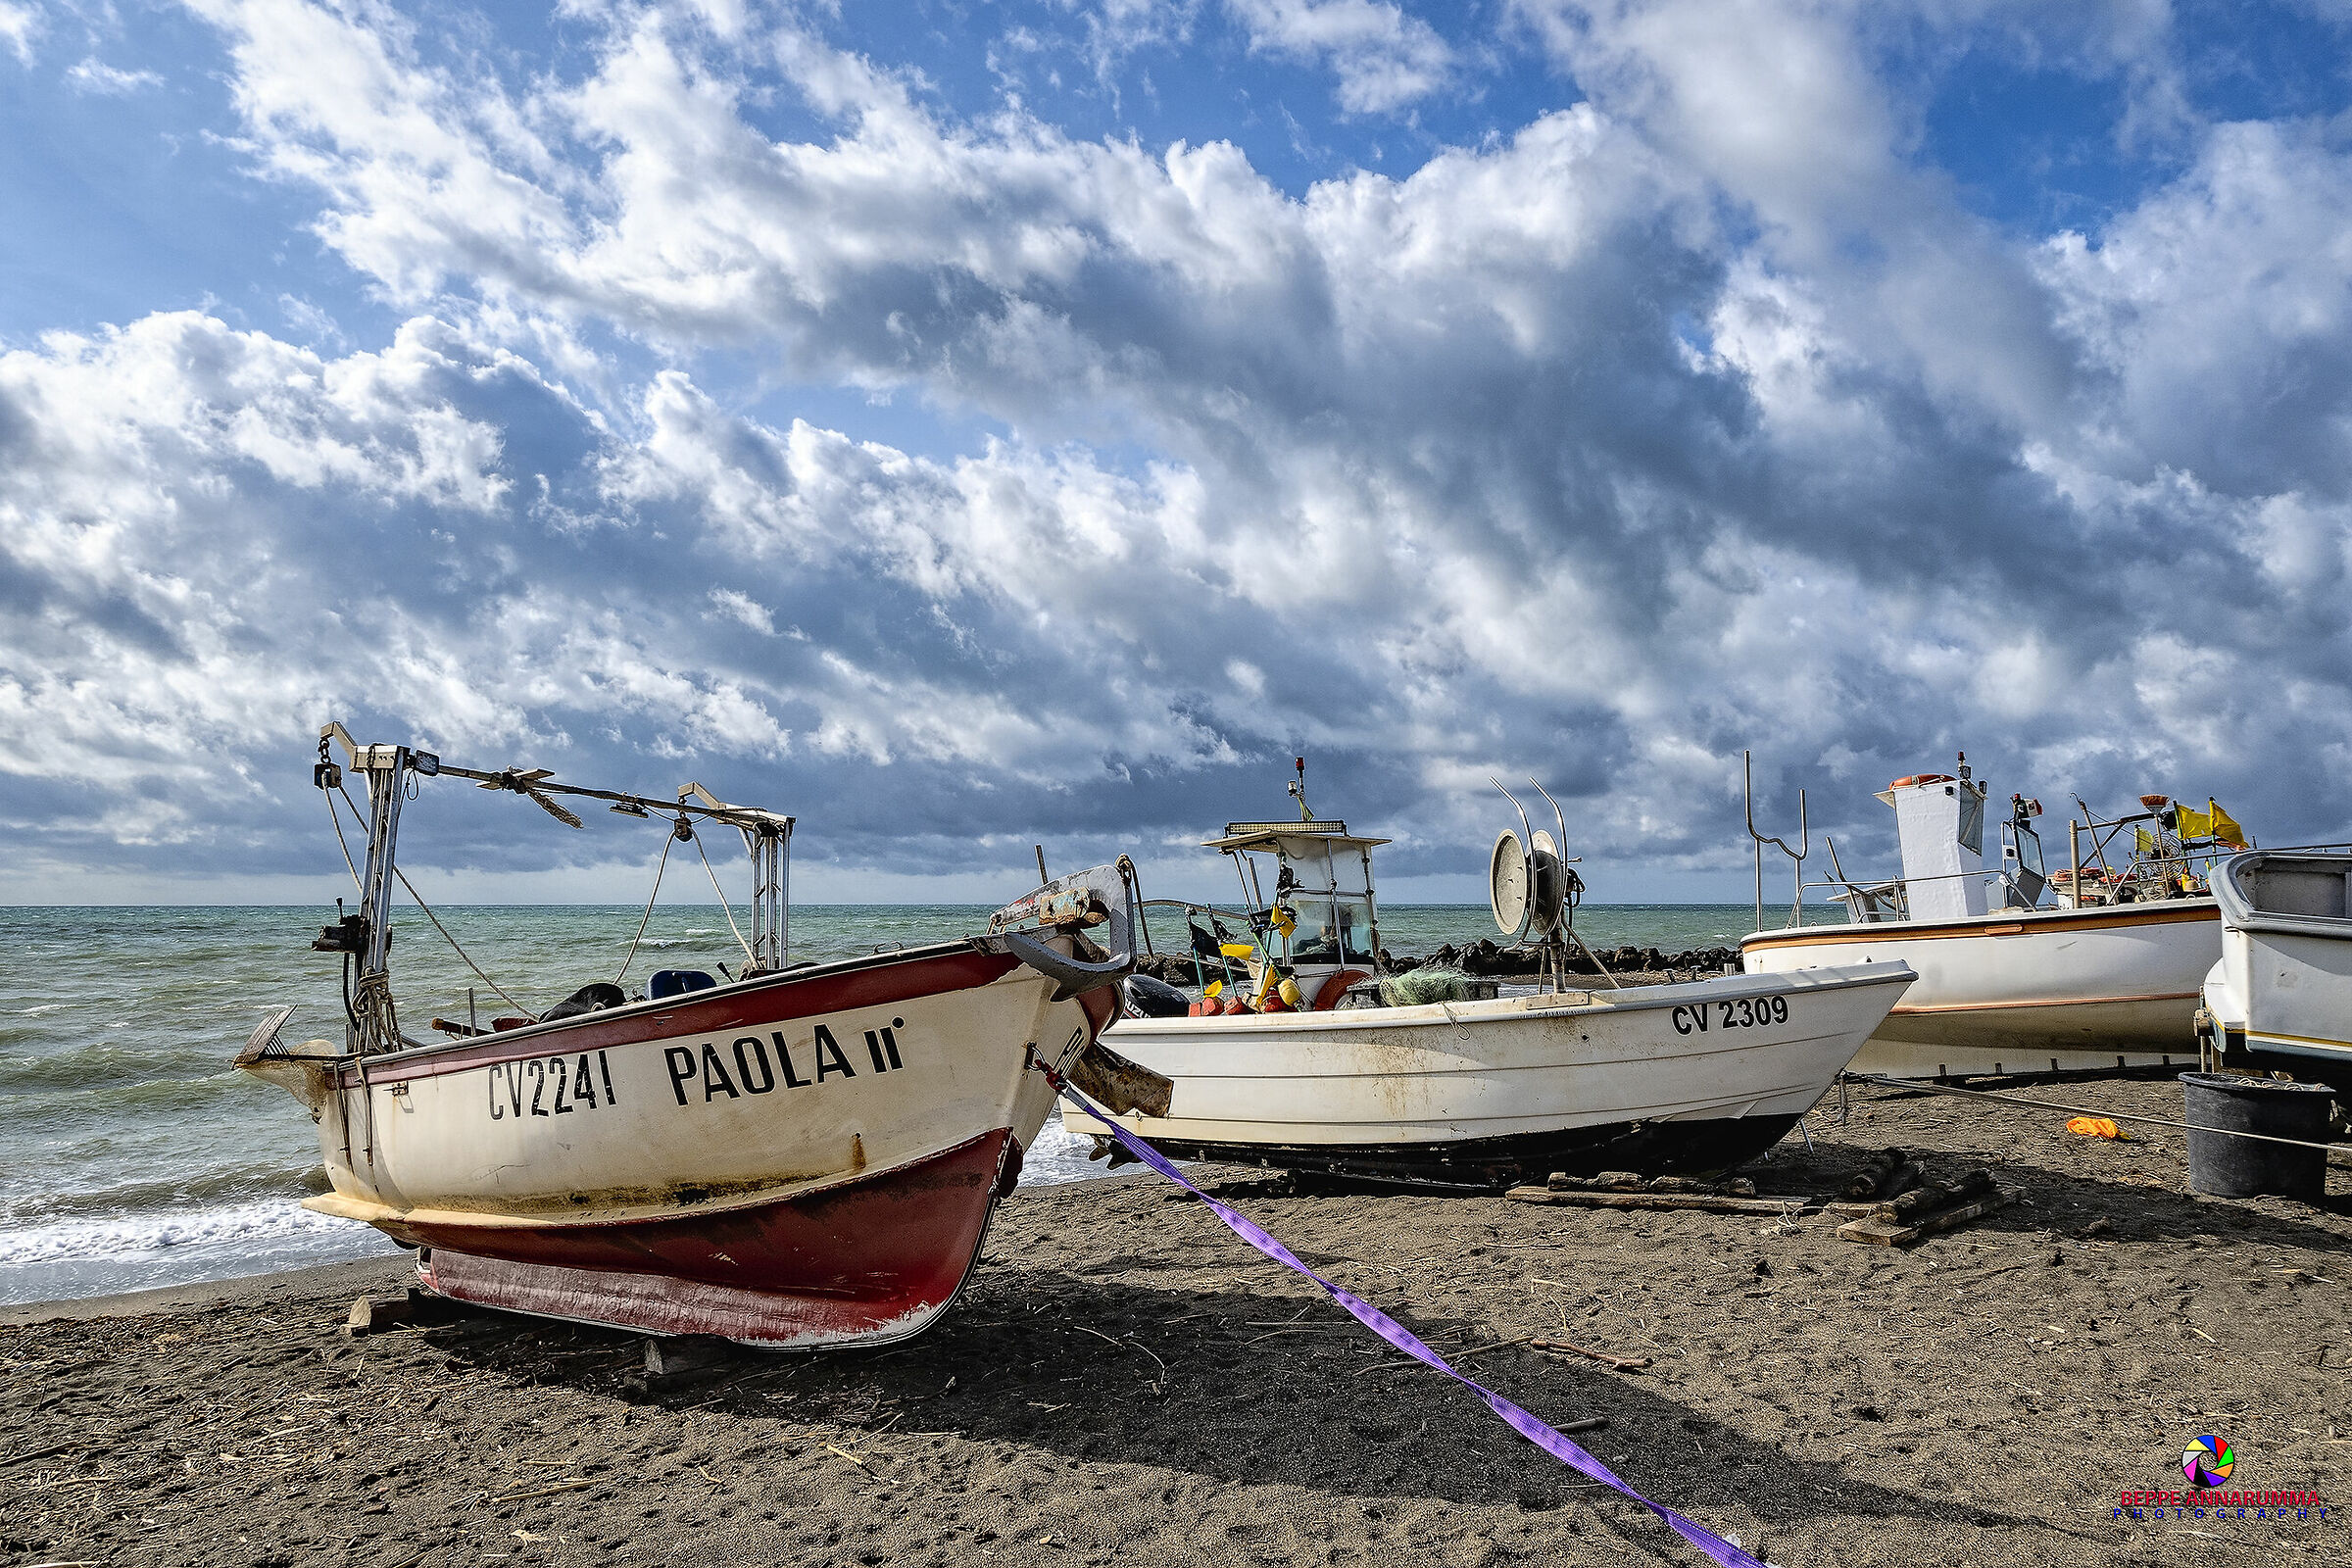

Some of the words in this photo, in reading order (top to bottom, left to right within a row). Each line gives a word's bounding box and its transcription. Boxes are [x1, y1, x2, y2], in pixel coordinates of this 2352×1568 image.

[1671, 1003, 1709, 1036] CV
[1718, 995, 1789, 1029] 2309
[489, 1050, 617, 1120] CV2241
[663, 1023, 858, 1106] PAOLA
